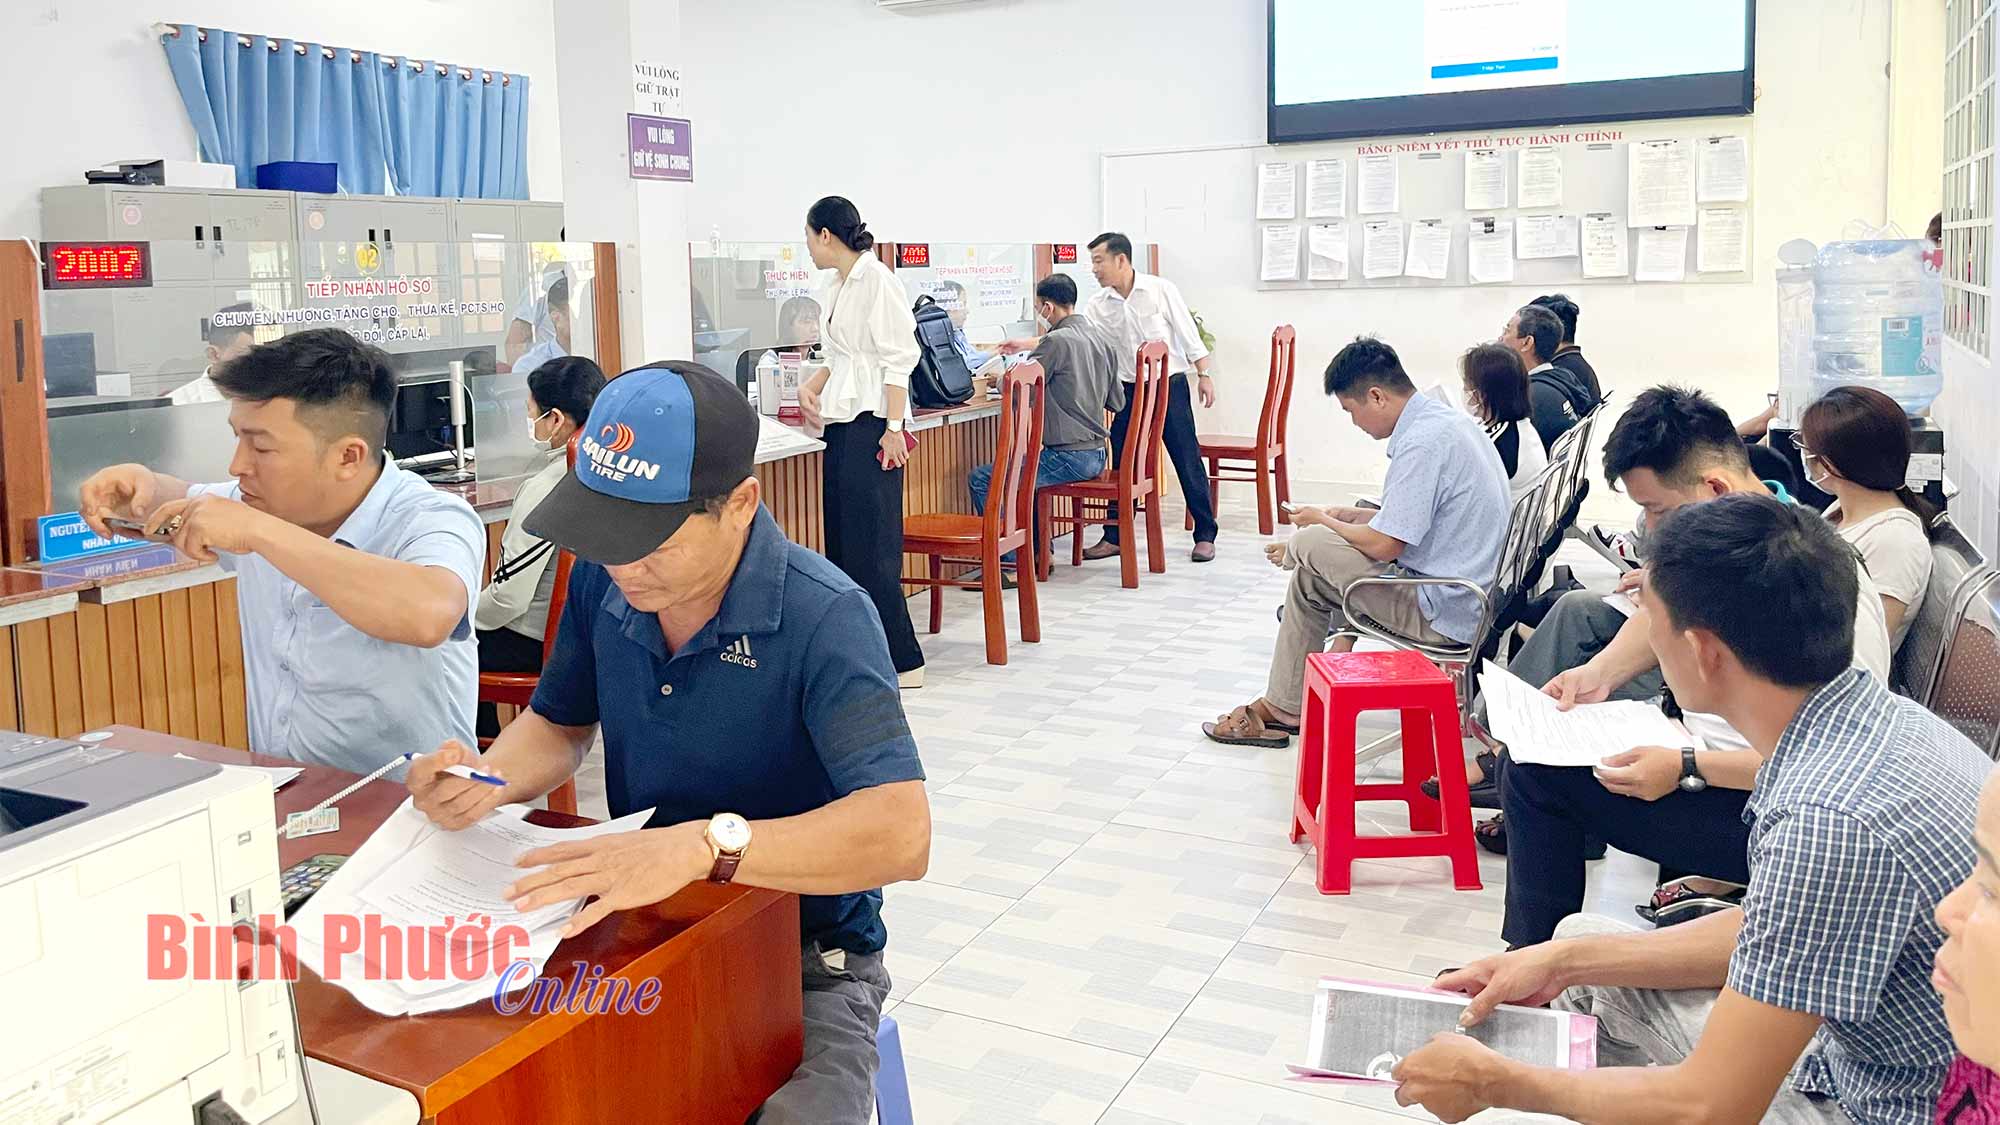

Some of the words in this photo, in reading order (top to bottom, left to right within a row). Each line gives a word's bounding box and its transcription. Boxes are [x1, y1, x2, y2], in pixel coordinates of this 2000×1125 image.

[636, 81, 654, 94] GIỮ
[647, 126, 658, 144] VUI
[659, 124, 675, 145] LÒNG
[1358, 144, 1393, 155] BẢNG
[1397, 141, 1430, 152] NIÊM
[1464, 135, 1492, 148] THỦ
[1529, 133, 1570, 145] HÀNH
[1575, 129, 1622, 142] CHÍNH
[306, 275, 340, 297] TIẾP
[344, 278, 385, 298] NHẬN
[388, 274, 408, 295] HỒ
[412, 278, 432, 294] SƠ
[214, 306, 273, 326] CHUYỂN
[461, 302, 488, 314] PCTS
[387, 323, 408, 341] CẤP
[583, 436, 661, 480] SAILUN
[590, 460, 627, 482] TIRE
